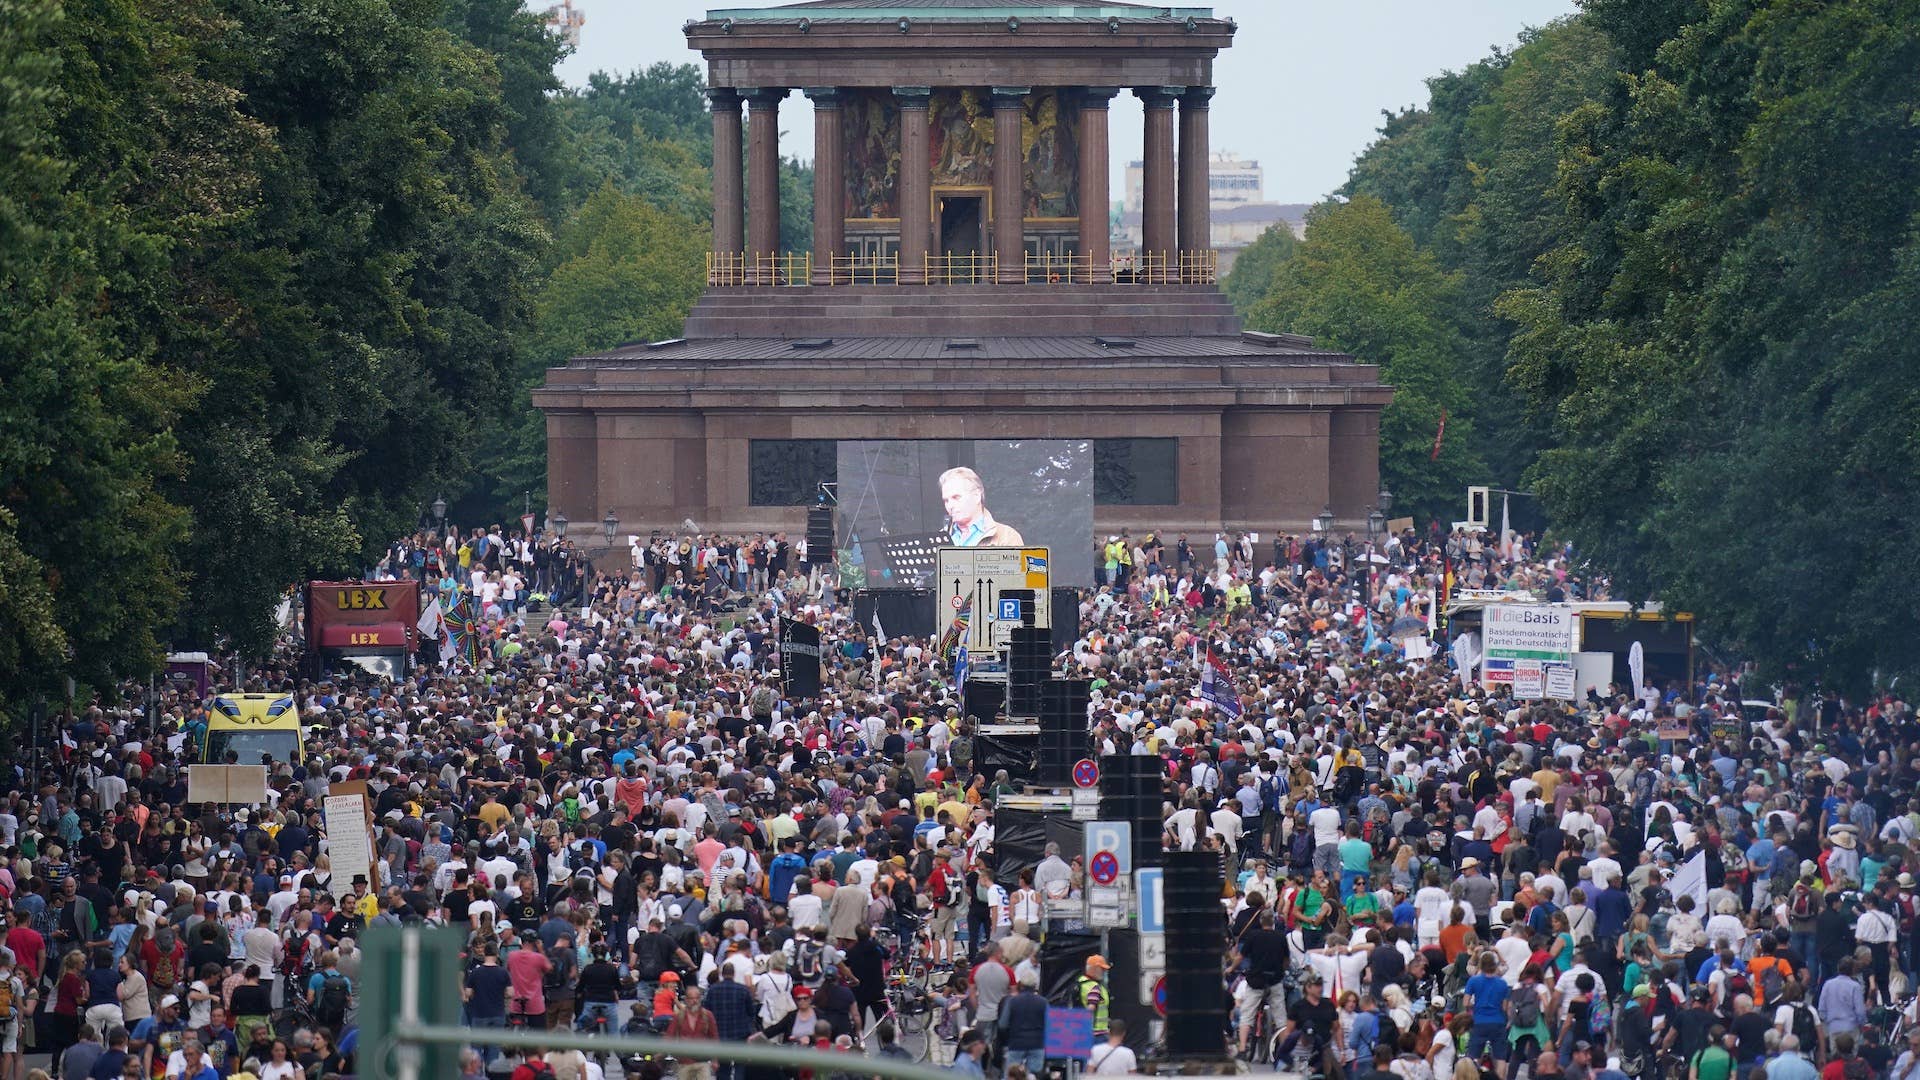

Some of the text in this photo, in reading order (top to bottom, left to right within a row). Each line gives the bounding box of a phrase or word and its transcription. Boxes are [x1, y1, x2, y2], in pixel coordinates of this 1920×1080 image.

[1002, 553, 1019, 561] Mitte
[338, 589, 387, 610] LEX
[1503, 610, 1560, 624] dieBasis
[351, 633, 379, 644] LEX
[1488, 627, 1569, 639] Basisdemokratische
[1488, 637, 1568, 648] Partei Deutschland
